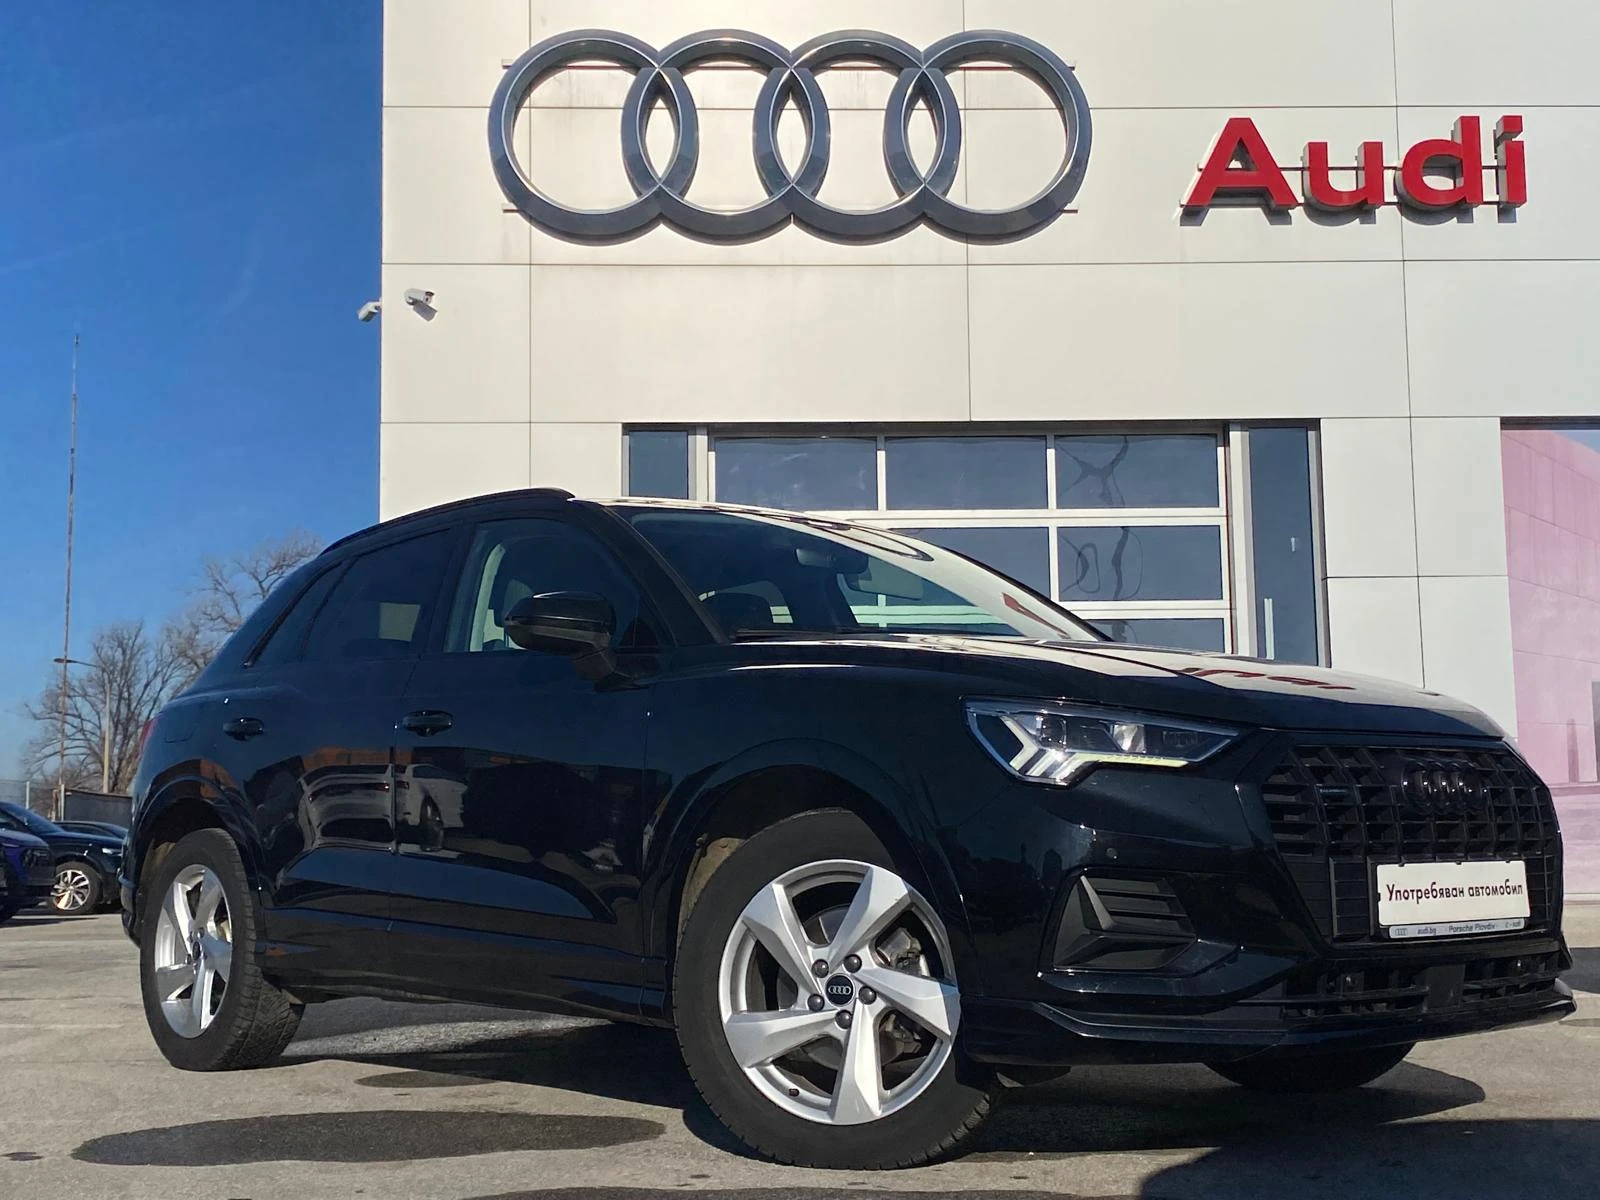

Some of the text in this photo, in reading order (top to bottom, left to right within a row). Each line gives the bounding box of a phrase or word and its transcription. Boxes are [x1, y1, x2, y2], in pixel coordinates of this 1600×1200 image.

[1183, 114, 1527, 209] Audi
[1386, 878, 1523, 904] Употребяван автомобил
